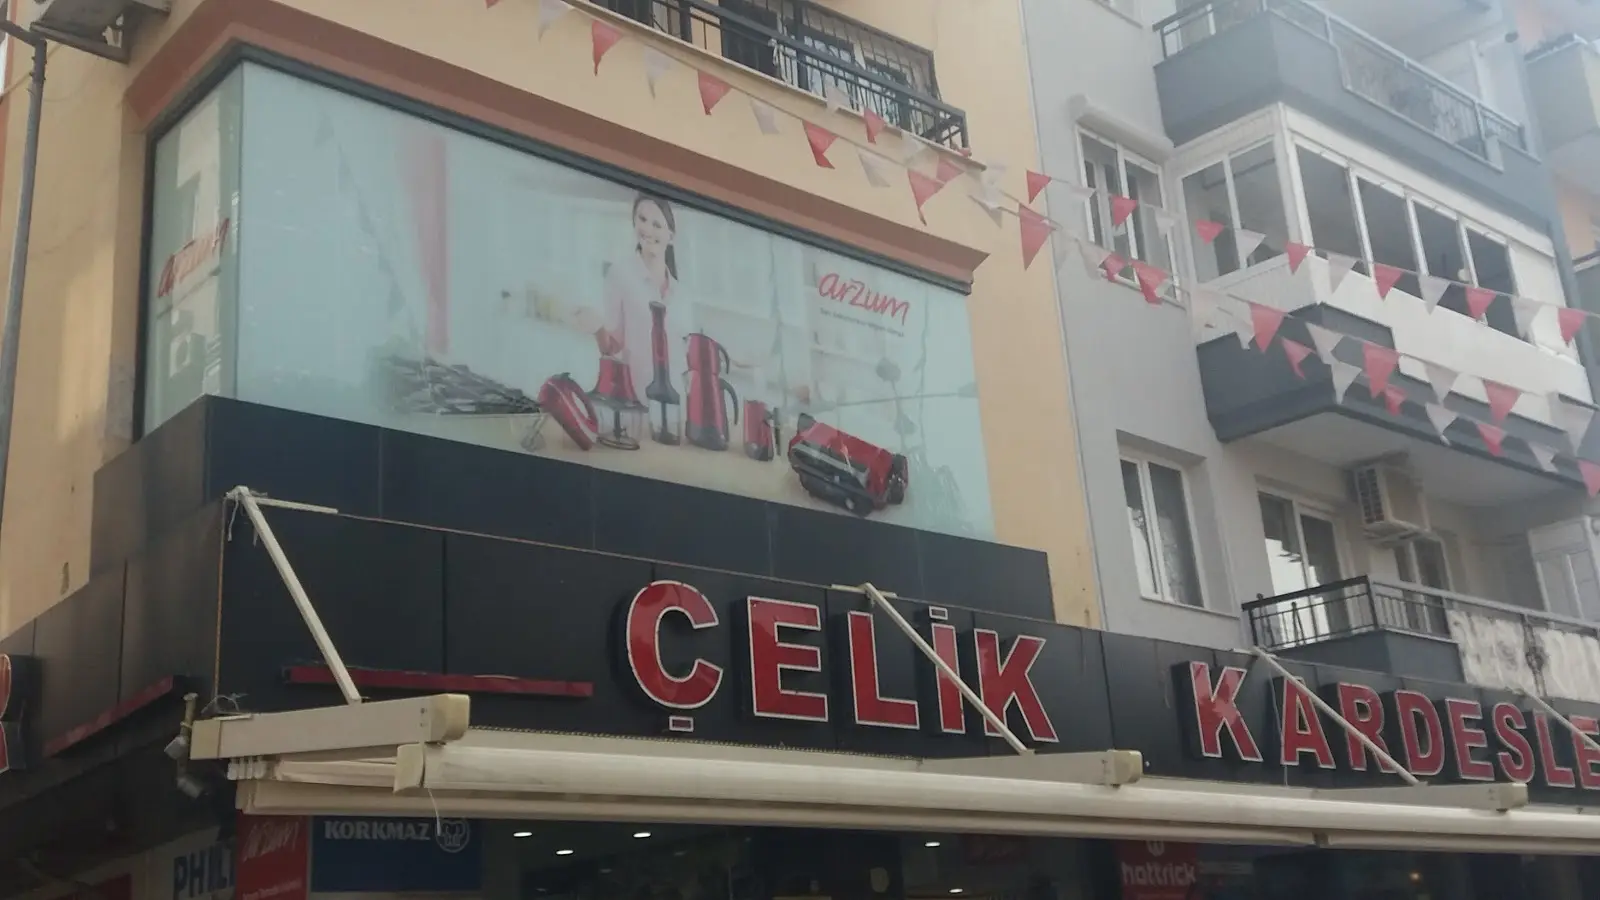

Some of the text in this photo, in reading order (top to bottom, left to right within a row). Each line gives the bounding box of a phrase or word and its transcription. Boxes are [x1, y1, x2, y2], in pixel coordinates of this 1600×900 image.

[818, 272, 910, 326] arzum
[625, 579, 1060, 743] ÇELİK
[323, 819, 431, 841] KORKMAZ
[1121, 860, 1197, 888] hattrick
